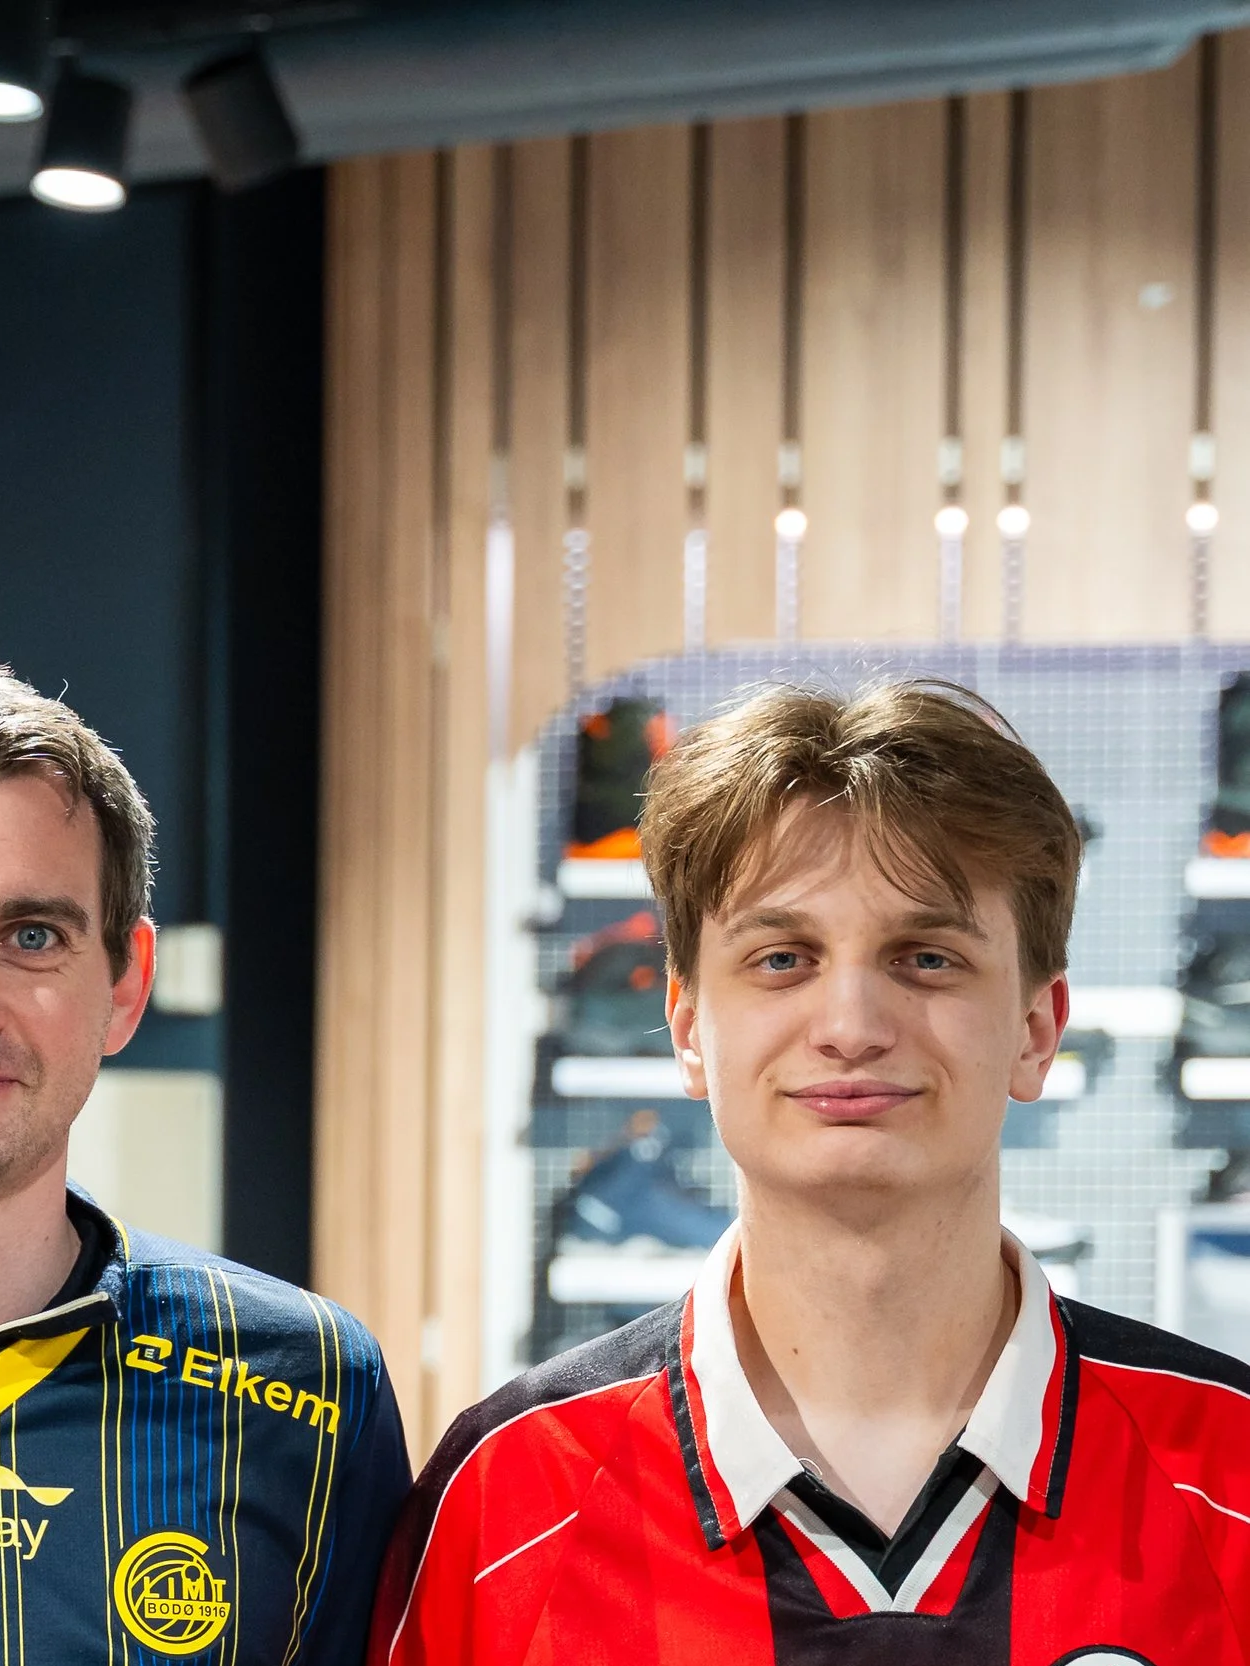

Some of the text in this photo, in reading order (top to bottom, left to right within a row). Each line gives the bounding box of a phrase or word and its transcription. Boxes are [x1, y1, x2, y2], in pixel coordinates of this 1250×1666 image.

[181, 1347, 341, 1434] Elkem
[148, 1603, 226, 1618] BODØ 1916
